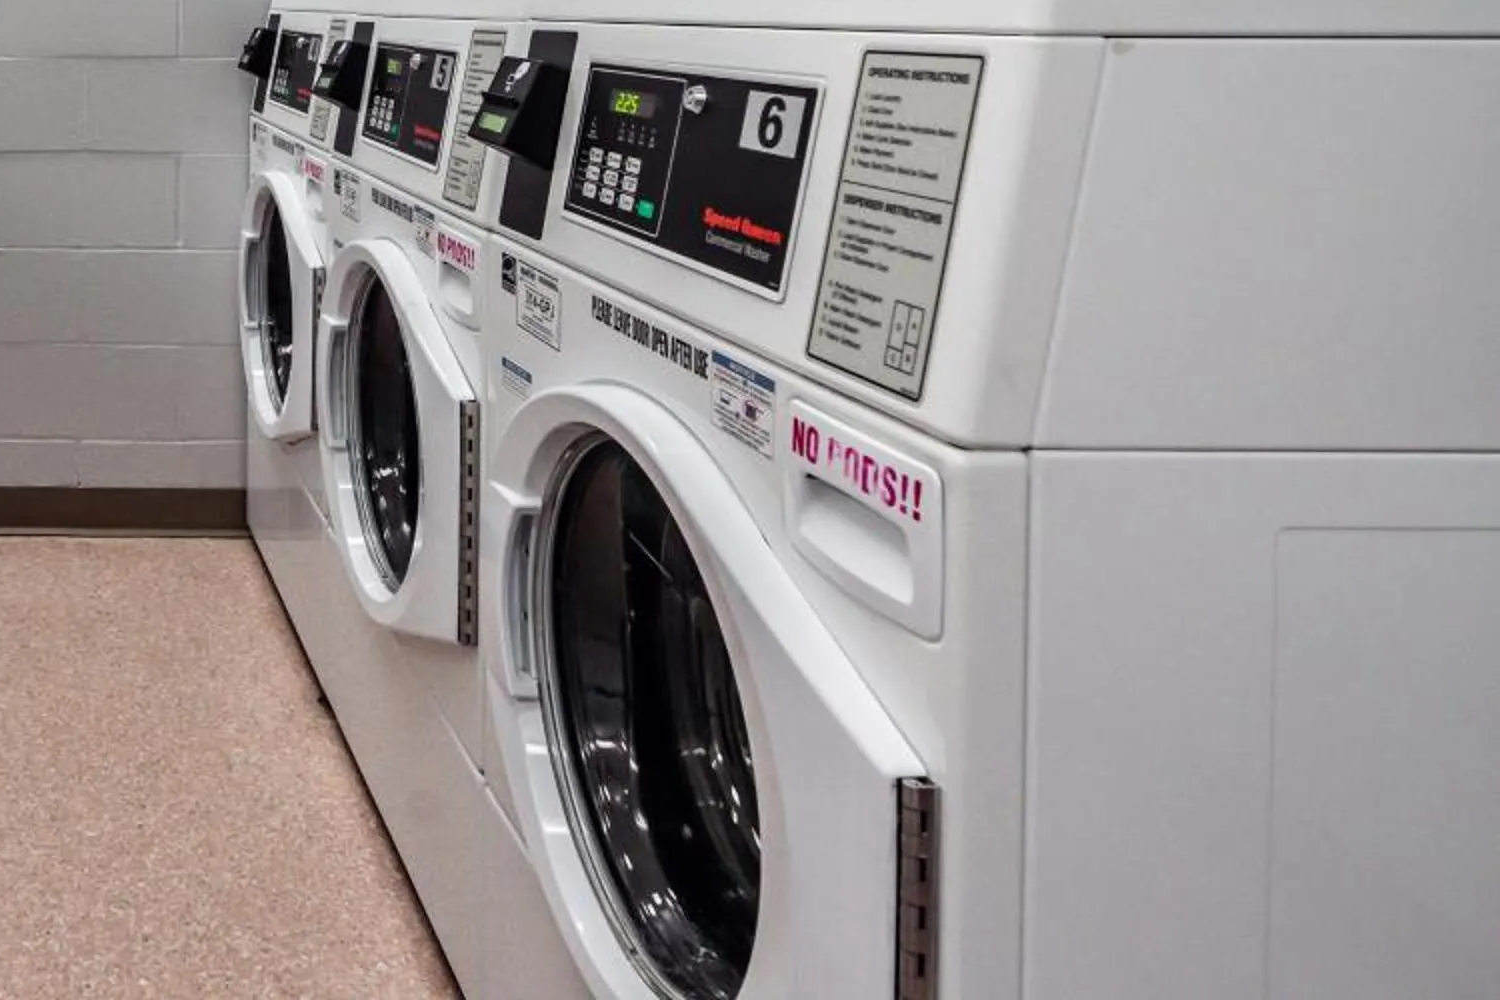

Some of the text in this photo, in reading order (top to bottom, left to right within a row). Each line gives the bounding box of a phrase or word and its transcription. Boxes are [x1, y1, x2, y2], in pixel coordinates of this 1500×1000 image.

[436, 58, 449, 88] 5
[757, 96, 787, 150] 6
[704, 206, 741, 233] Speed
[792, 416, 820, 465] NO
